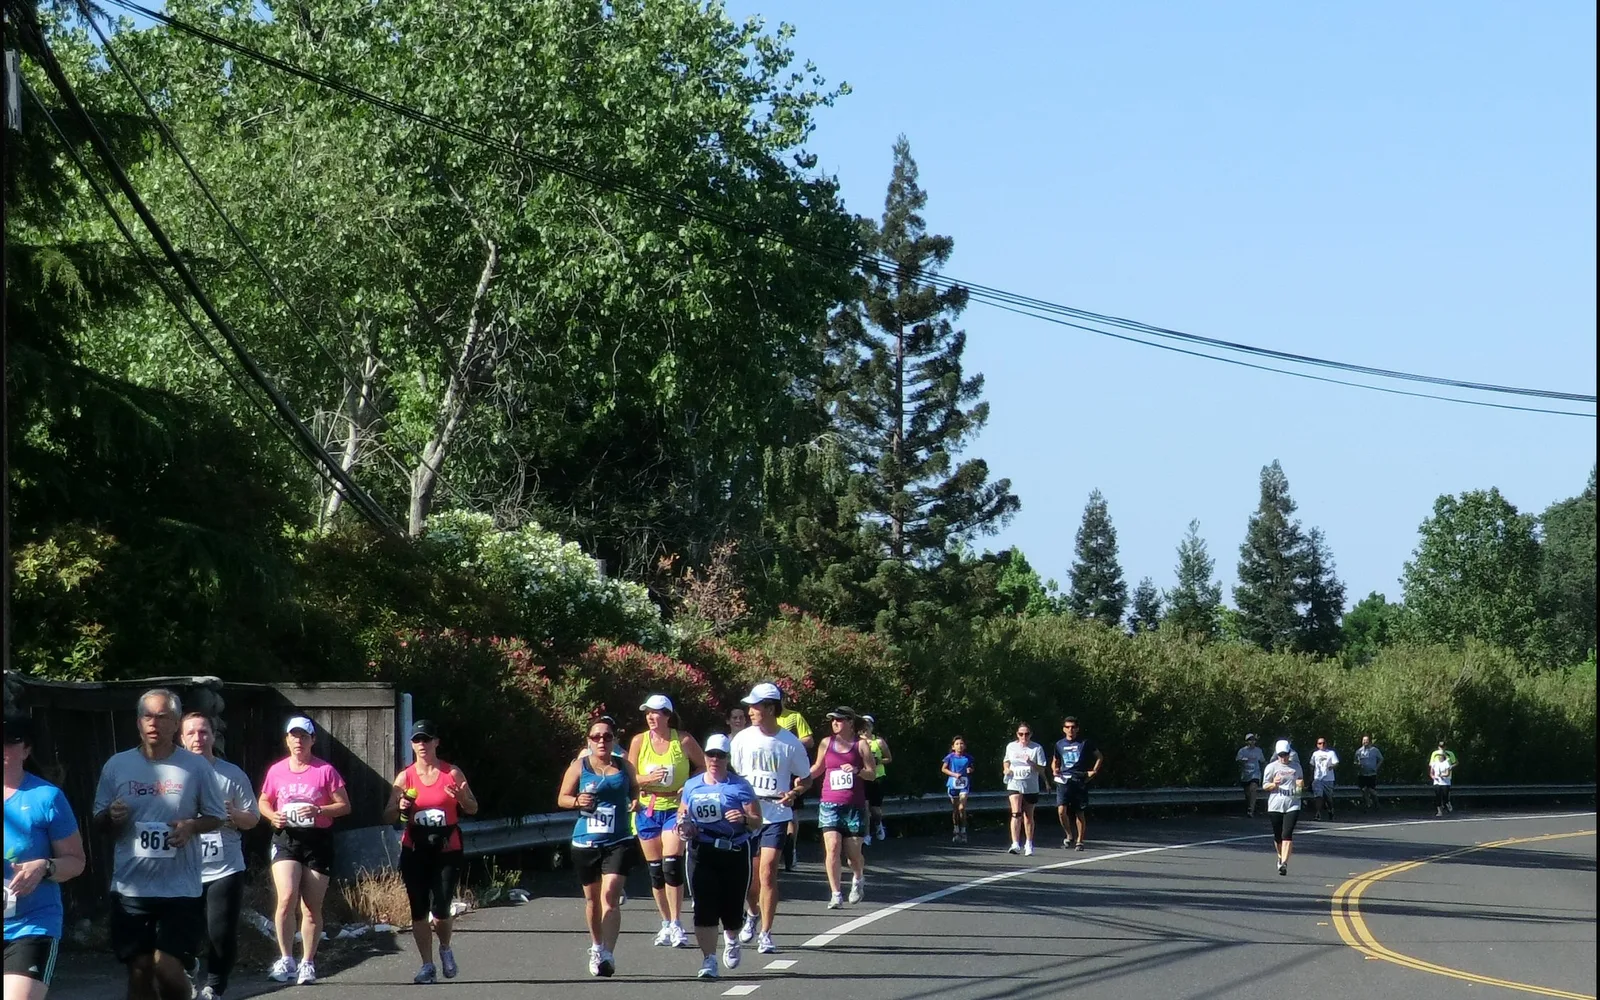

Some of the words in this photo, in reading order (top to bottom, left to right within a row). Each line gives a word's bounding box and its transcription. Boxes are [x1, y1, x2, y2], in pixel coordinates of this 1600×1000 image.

[753, 776, 777, 791] 1113
[831, 774, 852, 786] 1156
[696, 804, 717, 818] 859
[588, 813, 614, 827] 1197
[140, 830, 171, 851] 861
